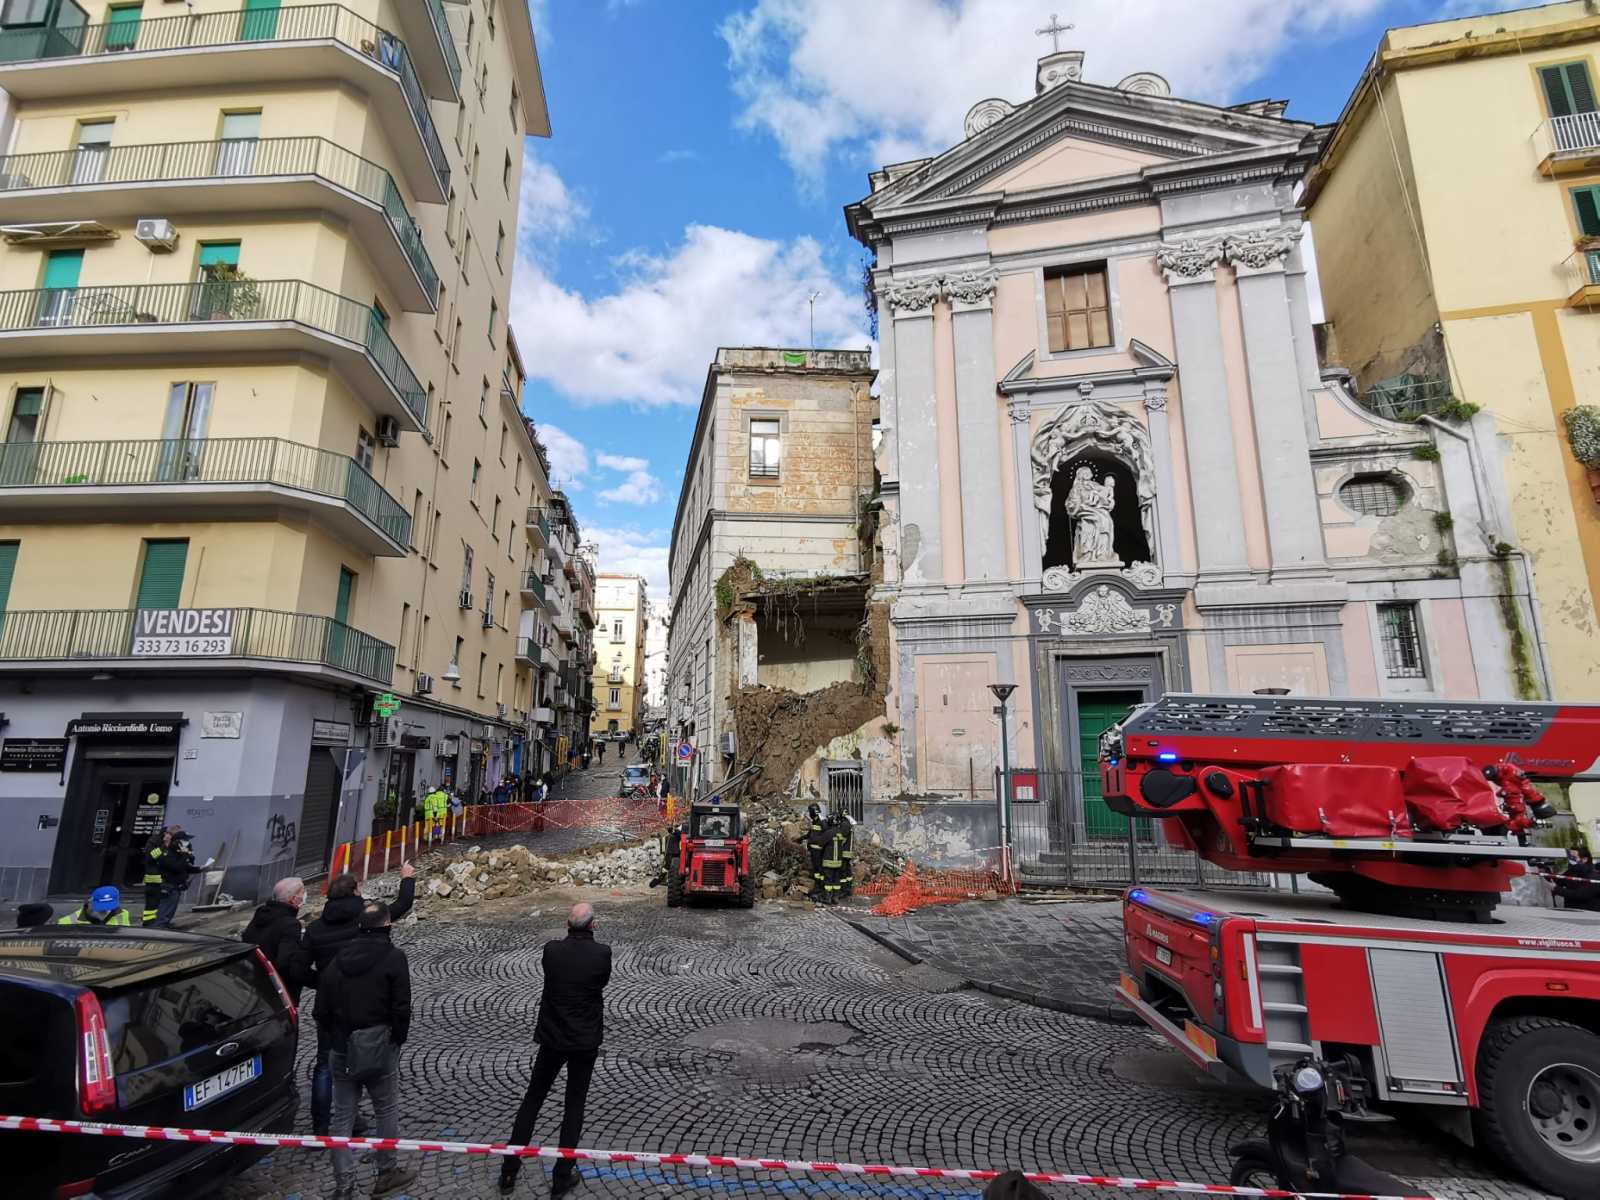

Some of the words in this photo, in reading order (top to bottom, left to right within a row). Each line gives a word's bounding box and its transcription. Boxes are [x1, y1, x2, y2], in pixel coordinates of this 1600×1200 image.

[143, 609, 232, 634] VENDESI
[137, 639, 161, 653] 333
[164, 639, 180, 653] 73
[185, 639, 200, 653] 16
[202, 639, 226, 653] 293
[72, 723, 100, 733] Antonio
[150, 723, 173, 733] Uomo
[195, 1079, 210, 1102] EF
[217, 1060, 253, 1091] 147FM
